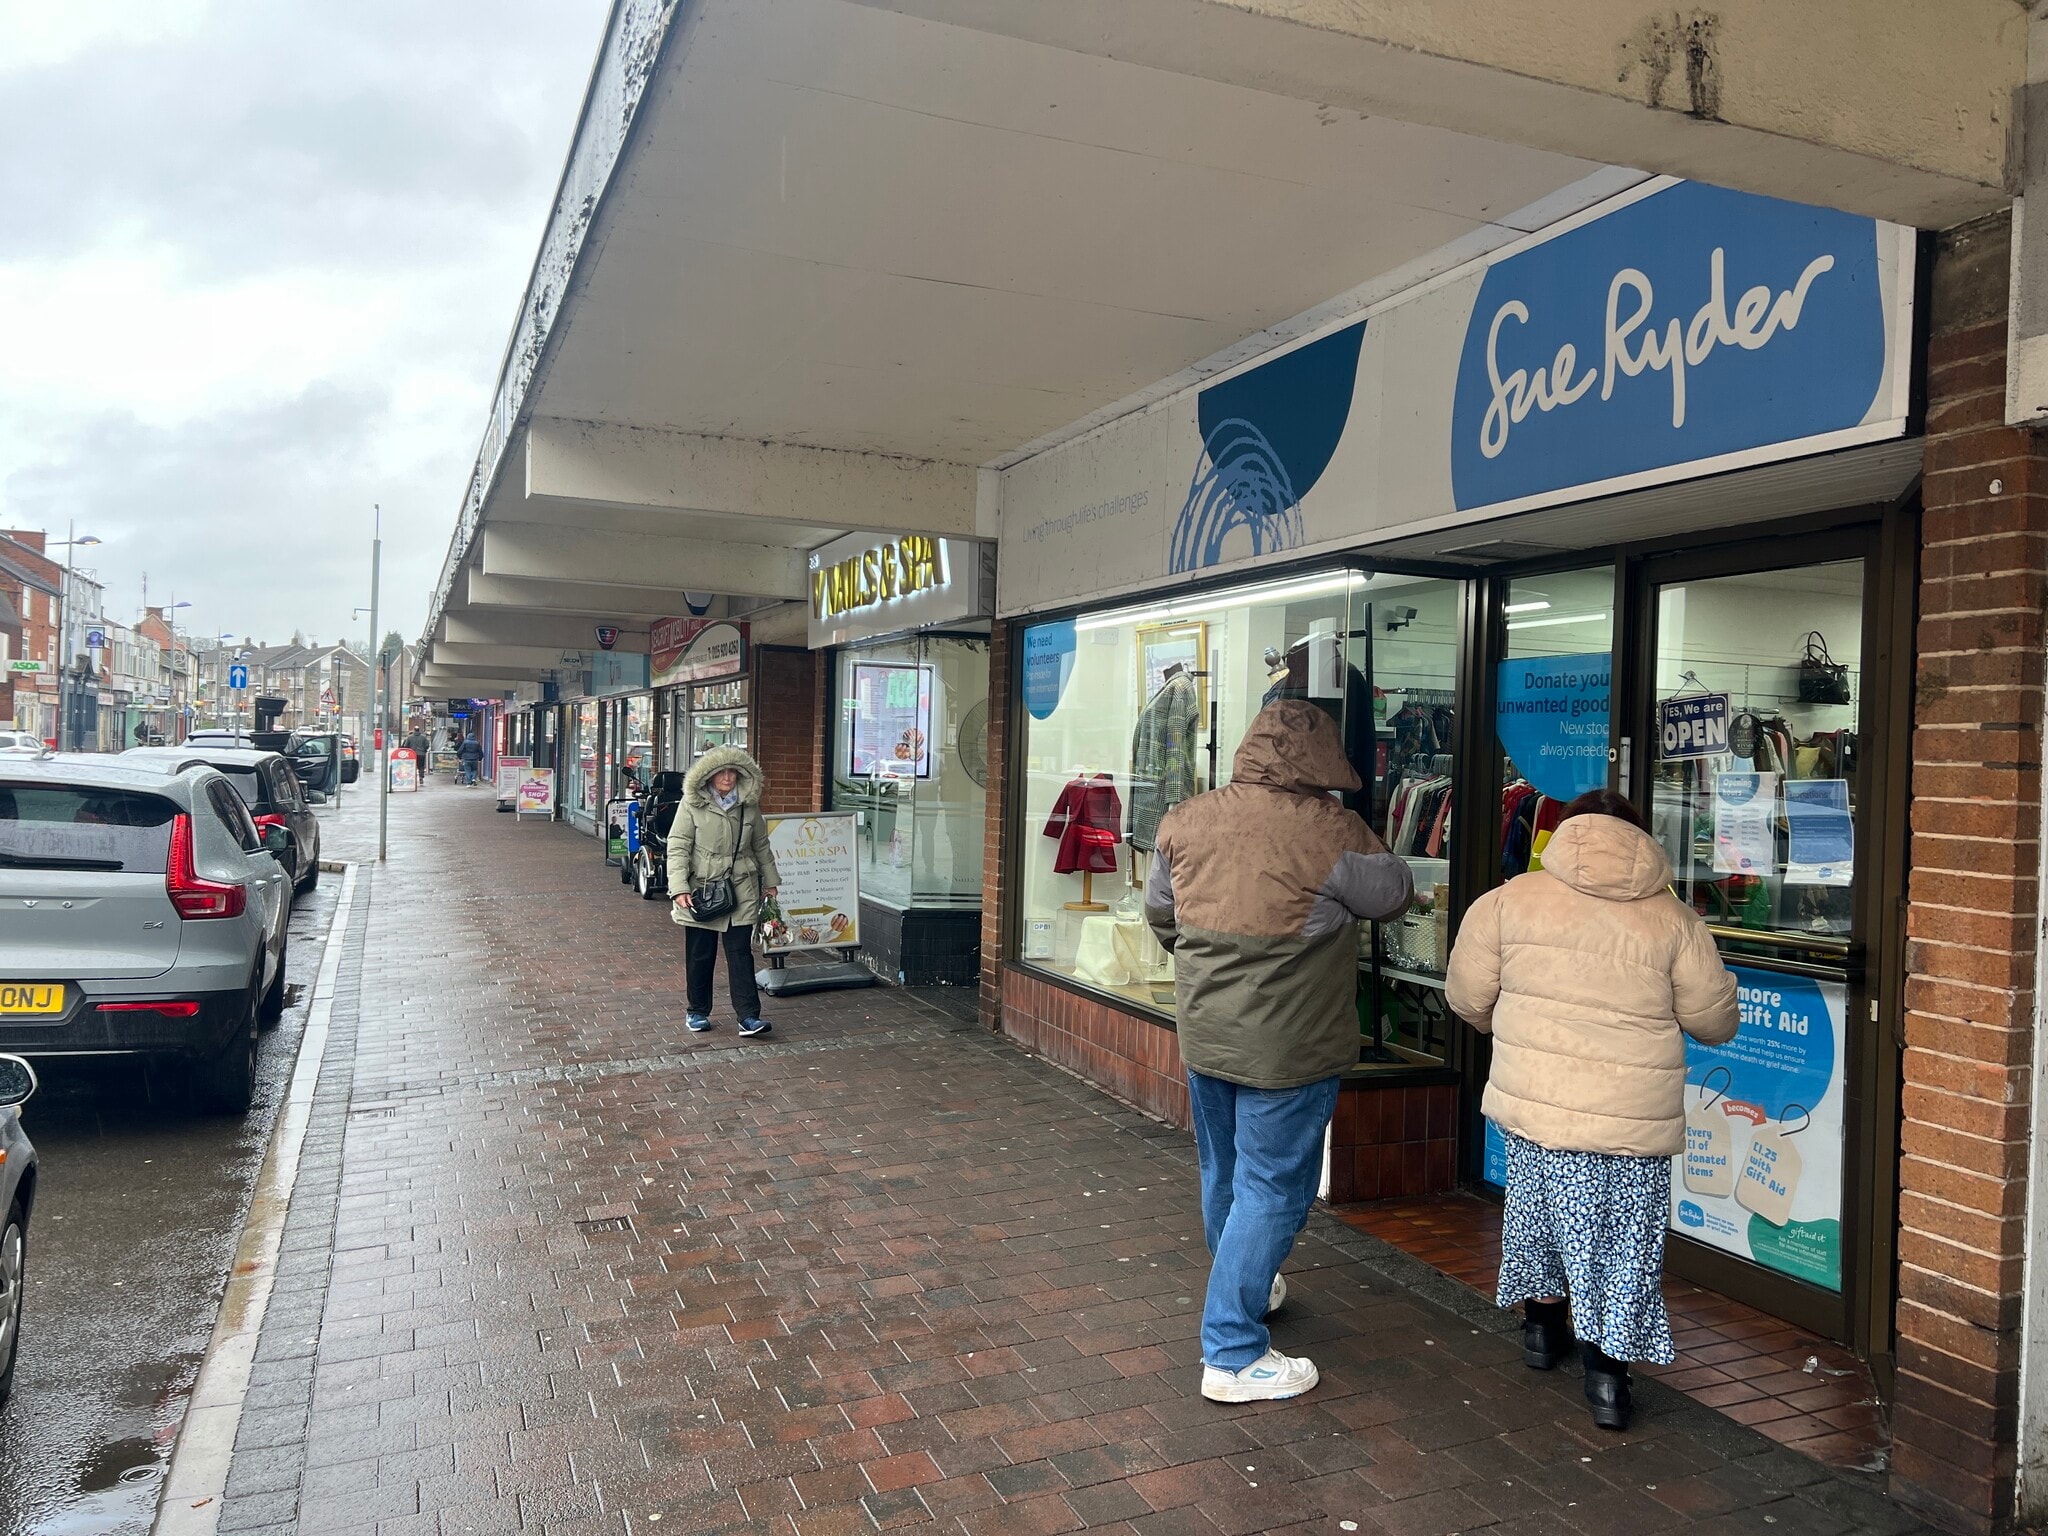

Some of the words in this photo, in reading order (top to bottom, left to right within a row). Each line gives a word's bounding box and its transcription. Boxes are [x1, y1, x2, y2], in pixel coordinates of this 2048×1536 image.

[1480, 300, 1597, 459] Sue
[1601, 247, 1835, 428] Ryder
[1023, 523, 1045, 543] Living
[1045, 509, 1079, 536] through
[1080, 504, 1096, 524] life's
[1099, 490, 1149, 519] challenges
[812, 569, 826, 619] V
[827, 550, 878, 617] NAILS
[880, 544, 897, 601] &
[900, 535, 949, 595] SPA
[1027, 634, 1036, 649] We
[1037, 632, 1052, 647] need
[12, 662, 40, 671] ASDA
[1027, 652, 1060, 667] volunteers
[1525, 673, 1577, 690] Donate
[1498, 696, 1568, 714] unwanted
[1684, 703, 1700, 715] We
[1704, 702, 1723, 713] are
[1560, 721, 1584, 735] New
[1664, 717, 1726, 751] OPEN
[1540, 742, 1573, 760] always
[1723, 779, 1753, 788] Opening
[805, 826, 818, 841] V
[786, 847, 816, 859] NAILS
[818, 847, 825, 857] &
[827, 846, 848, 857] SPA
[1736, 985, 1782, 1008] more
[1738, 1003, 1772, 1028] Gift
[1778, 1011, 1809, 1036] Aid
[1688, 1042, 1696, 1050] no
[1697, 1045, 1708, 1053] one
[1708, 1046, 1719, 1055] has
[1720, 1049, 1727, 1057] to
[1727, 1050, 1739, 1060] face
[1740, 1053, 1758, 1064] death
[1748, 1036, 1766, 1045] worth
[1767, 1040, 1780, 1049] 25%
[1781, 1044, 1798, 1053] more
[1798, 1046, 1807, 1056] by
[1749, 1046, 1761, 1055] and
[1761, 1048, 1774, 1059] help
[1783, 1055, 1806, 1065] ensure
[1726, 1103, 1759, 1119] becomes
[1687, 1126, 1712, 1140] Every
[1687, 1139, 1696, 1149] £1
[1698, 1141, 1708, 1151] of
[1753, 1141, 1777, 1162] £1.25
[1687, 1152, 1727, 1166] donated
[1750, 1155, 1772, 1174] with
[1687, 1165, 1713, 1177] items
[1746, 1166, 1766, 1185] Gift
[1768, 1180, 1786, 1196] Aid
[1817, 1233, 1827, 1243] it
